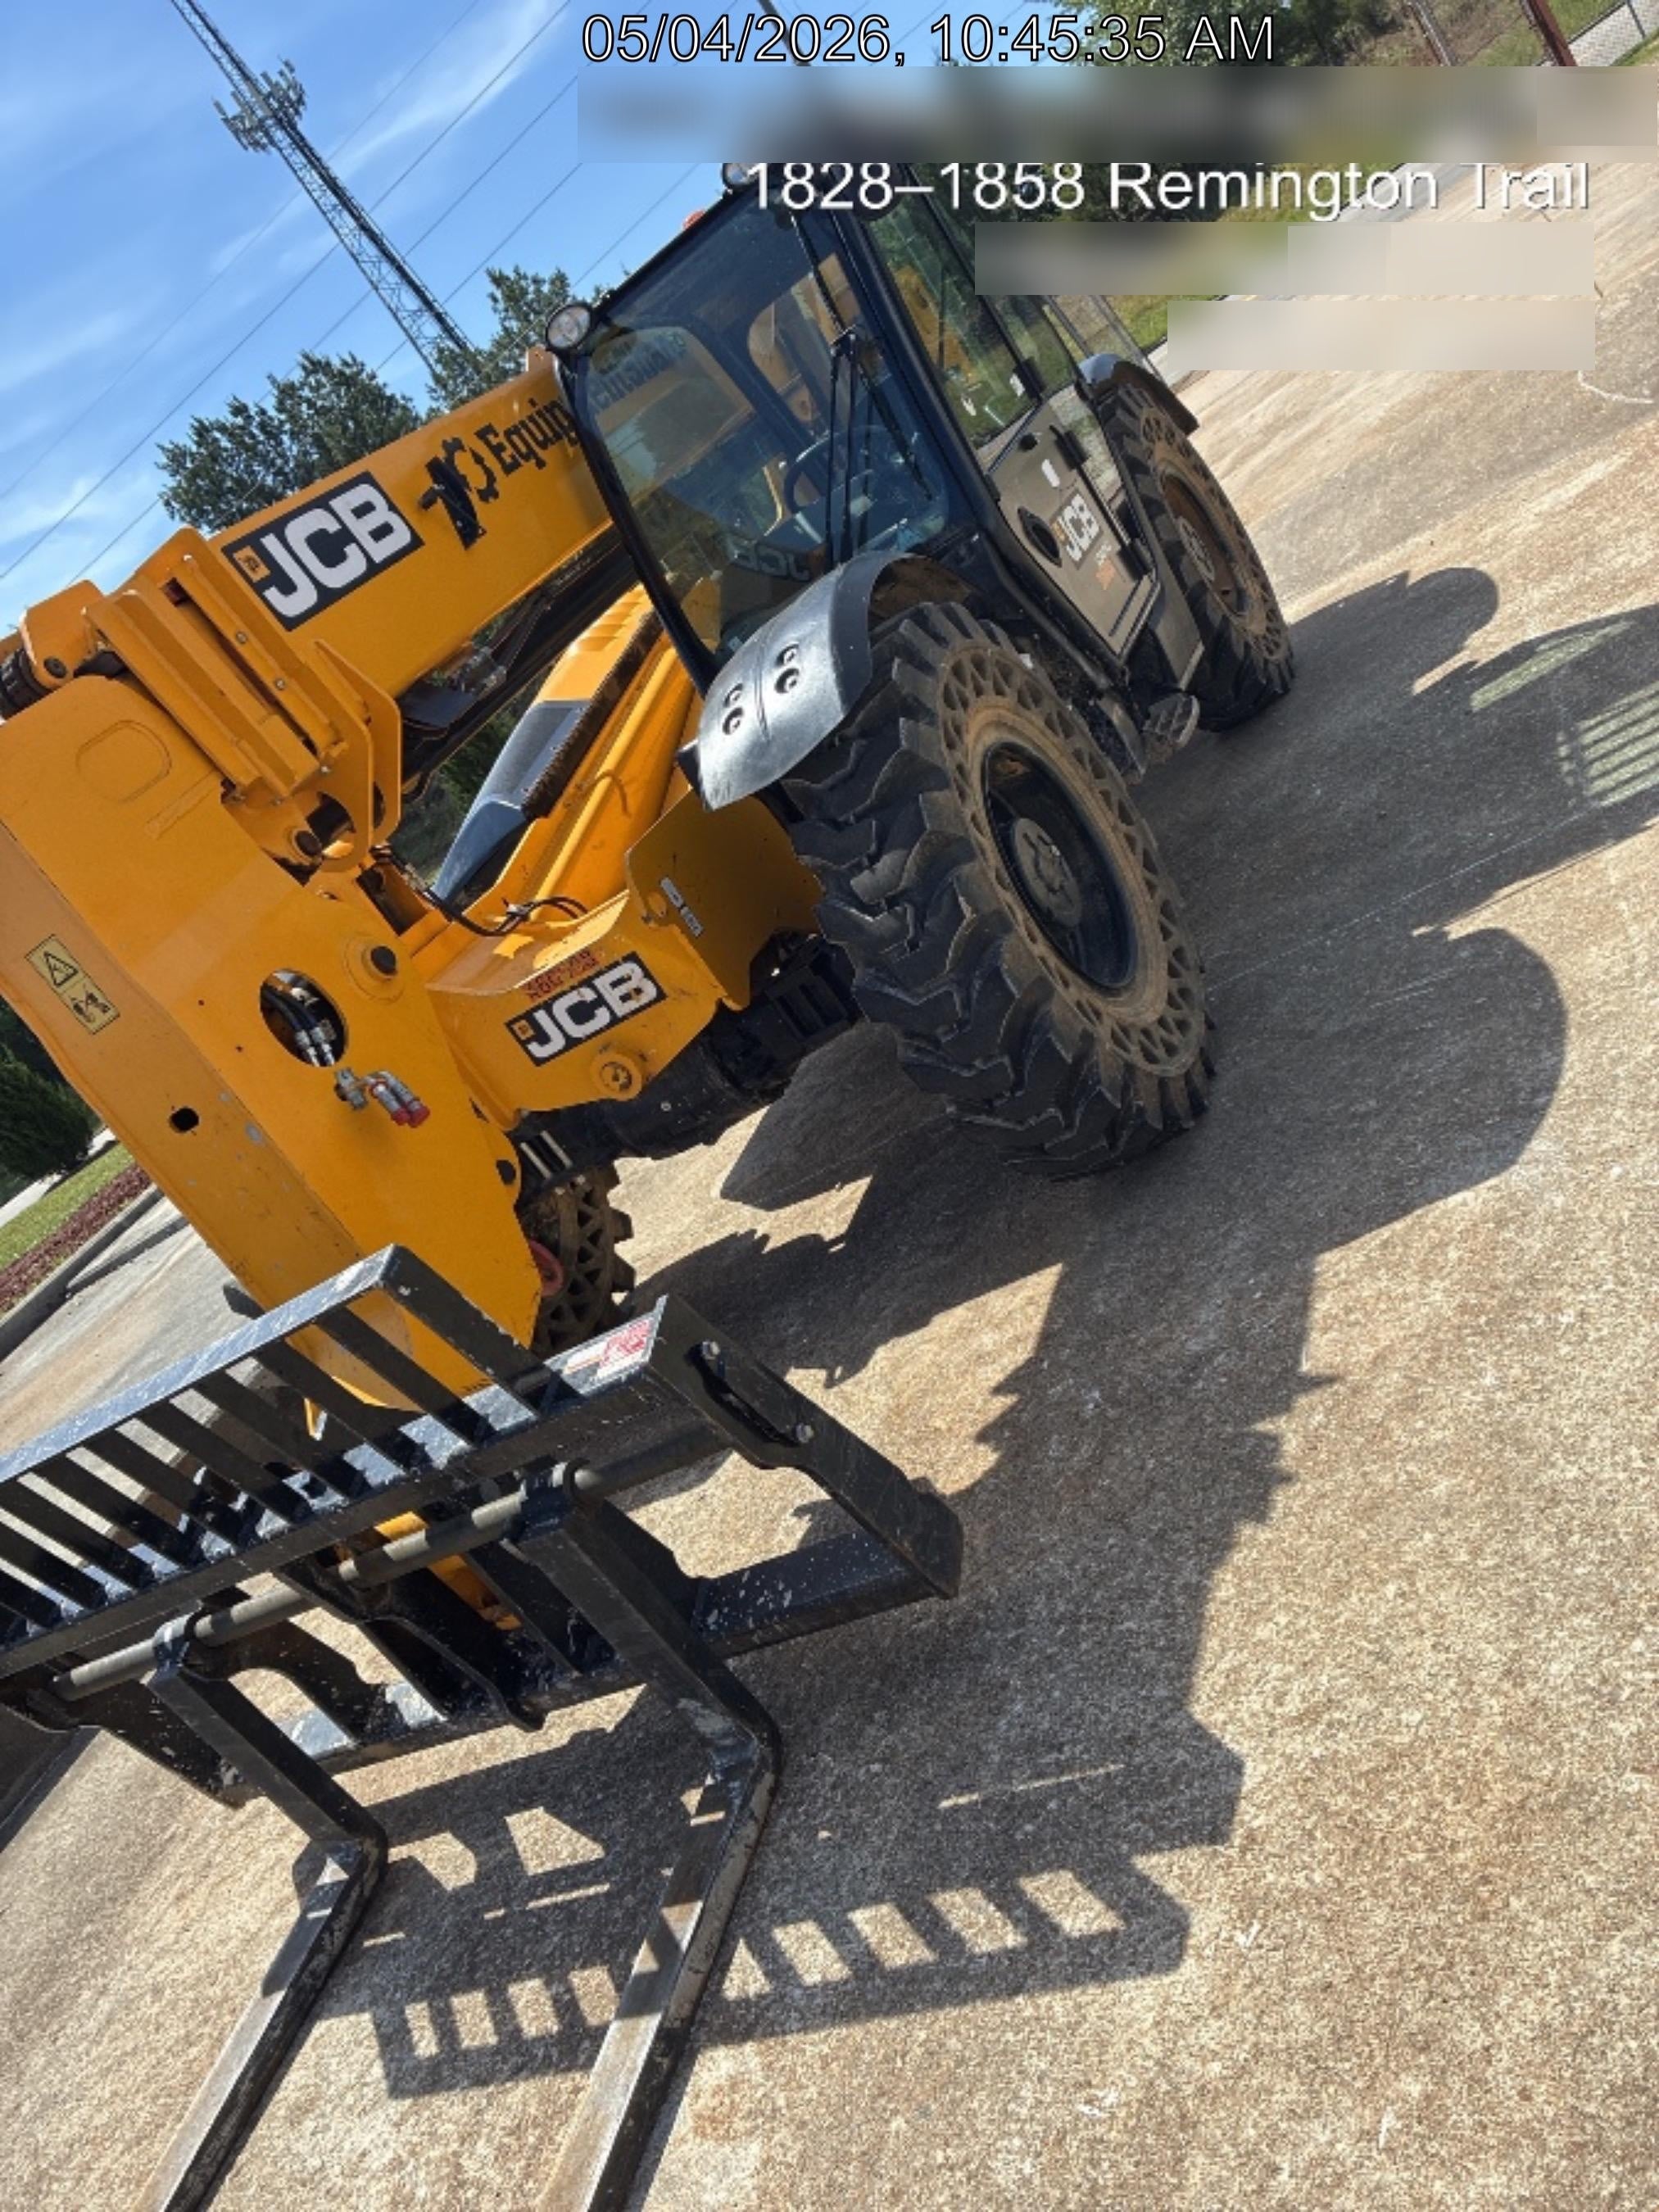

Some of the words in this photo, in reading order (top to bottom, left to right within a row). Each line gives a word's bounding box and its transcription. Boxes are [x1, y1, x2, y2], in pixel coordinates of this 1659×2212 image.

[260, 483, 412, 618] JCB
[1057, 493, 1099, 561] JCB
[527, 962, 658, 1058] JCB
